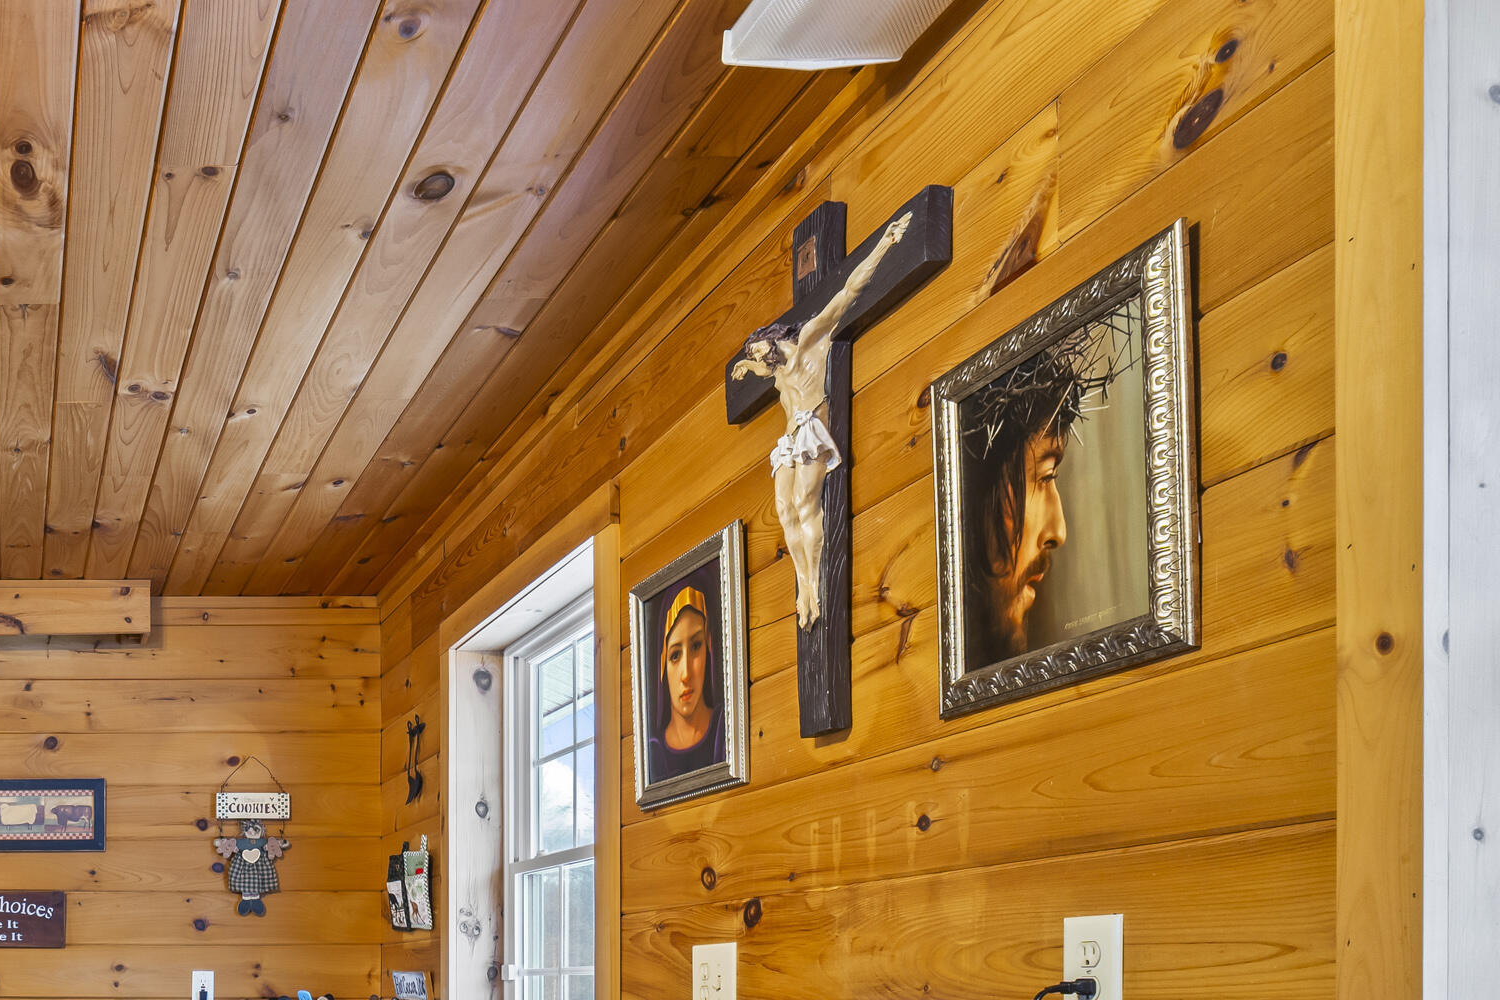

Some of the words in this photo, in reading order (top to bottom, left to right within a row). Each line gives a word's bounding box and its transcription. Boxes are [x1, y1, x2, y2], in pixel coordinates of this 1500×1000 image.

[228, 802, 278, 814] COOKIES
[7, 919, 19, 929] It
[11, 931, 24, 941] It
